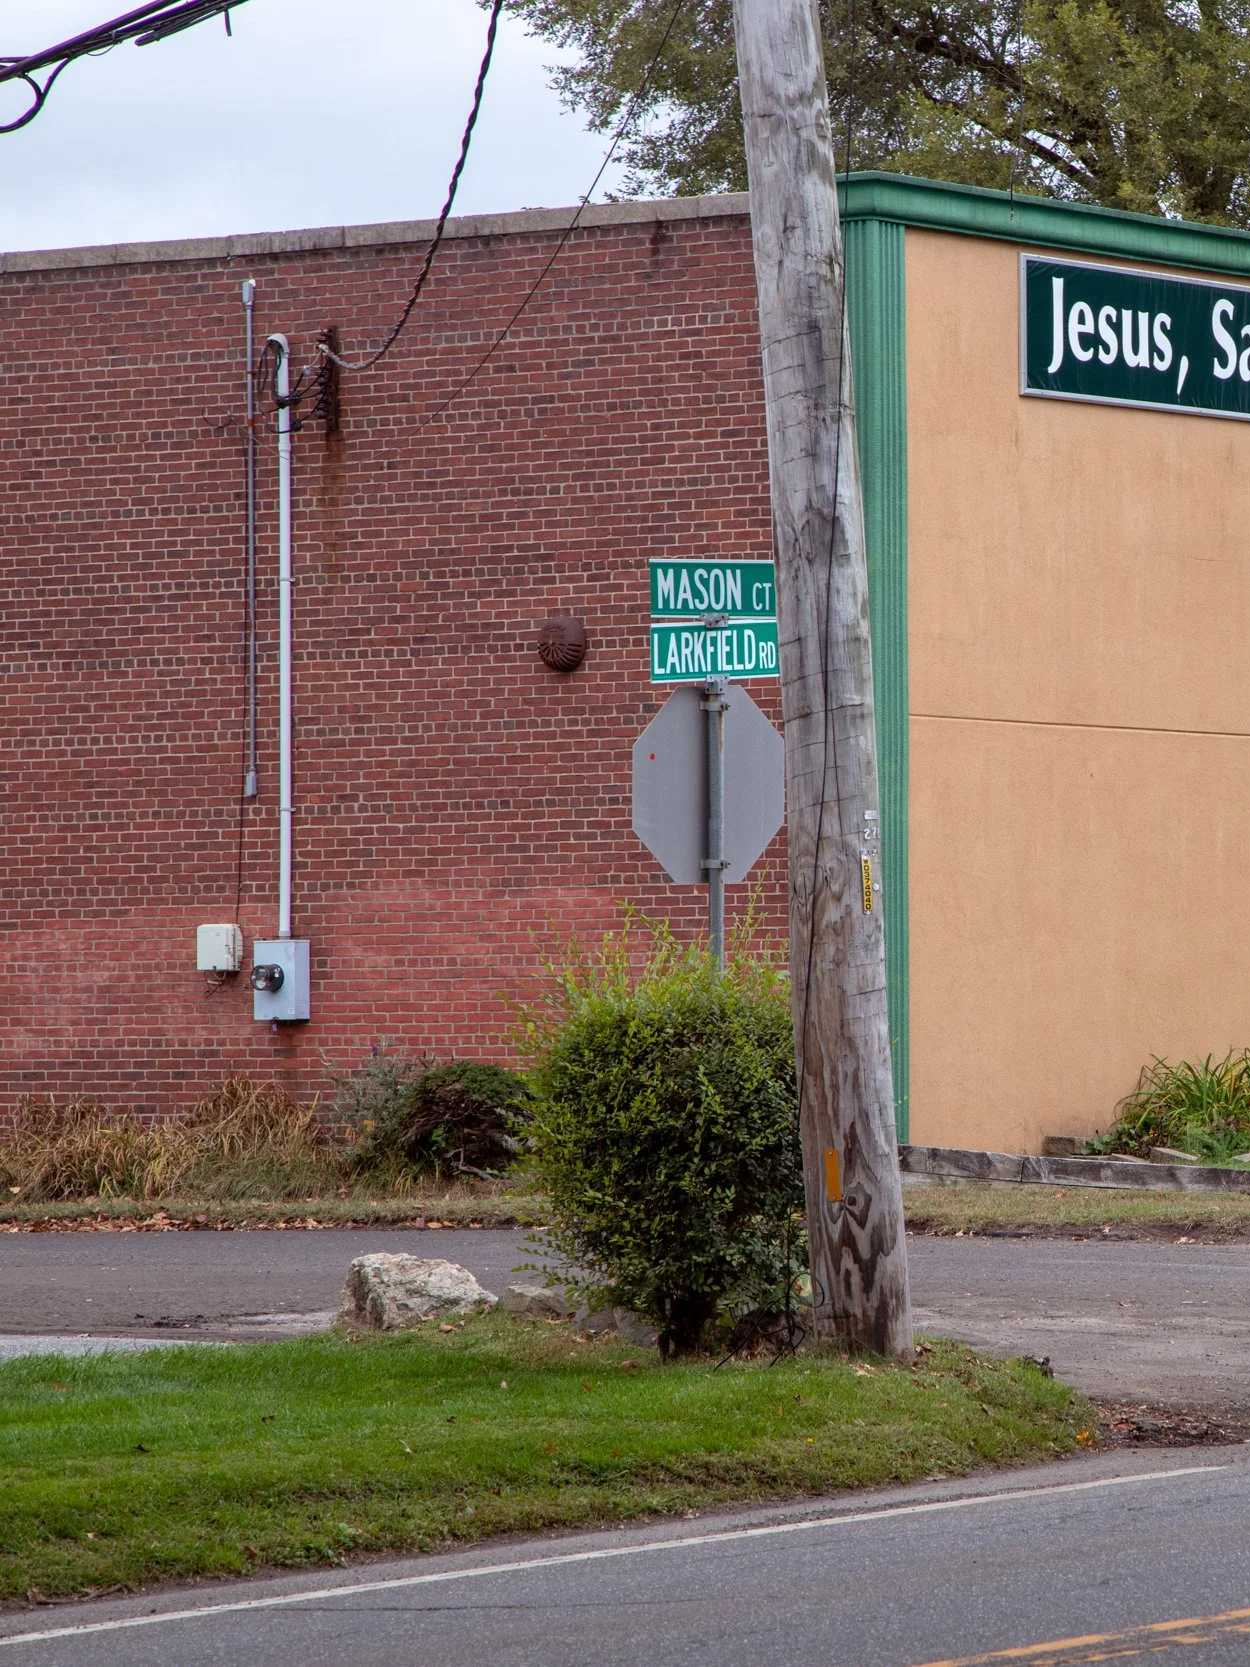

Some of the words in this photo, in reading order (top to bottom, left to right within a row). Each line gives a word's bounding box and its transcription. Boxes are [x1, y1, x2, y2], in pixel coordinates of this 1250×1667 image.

[1048, 275, 1190, 396] Jesus,
[656, 568, 742, 611] MASON
[752, 582, 772, 611] CT
[653, 629, 756, 675] LARKFIELD
[758, 641, 776, 670] RD
